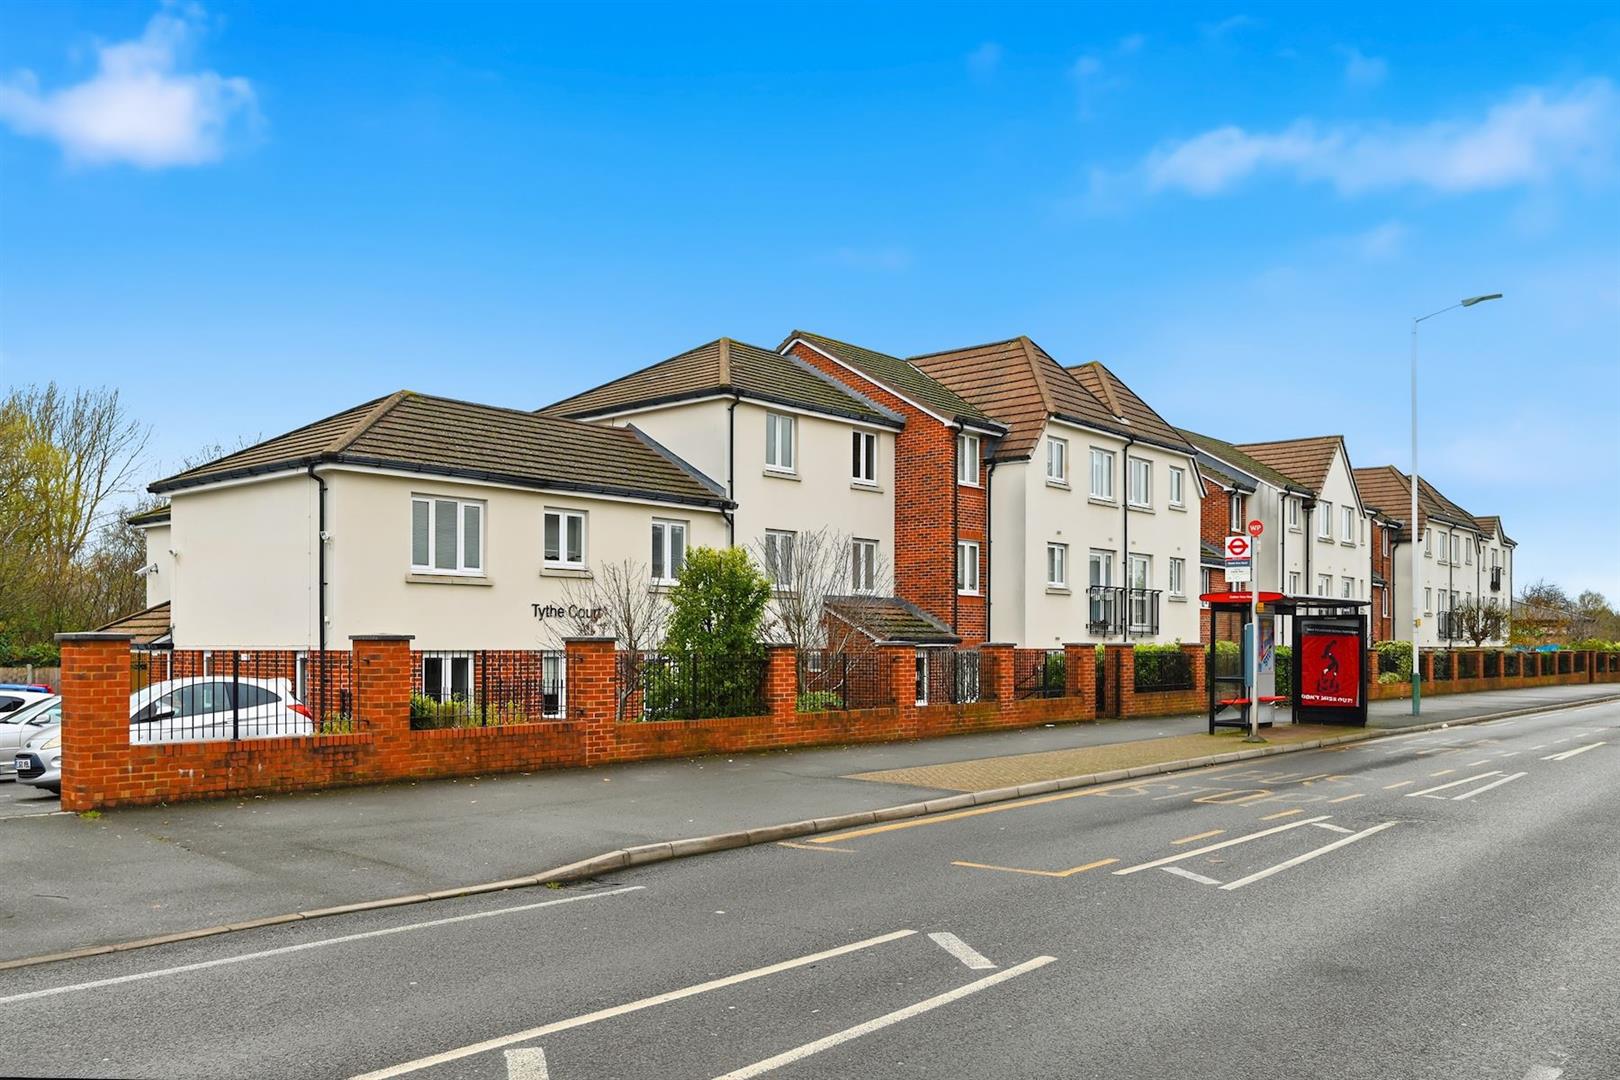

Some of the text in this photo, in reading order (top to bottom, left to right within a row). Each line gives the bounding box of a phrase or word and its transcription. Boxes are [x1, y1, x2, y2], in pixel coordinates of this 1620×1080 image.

[531, 603, 602, 621] Tythe Court
[1095, 784, 1329, 807] STOP
